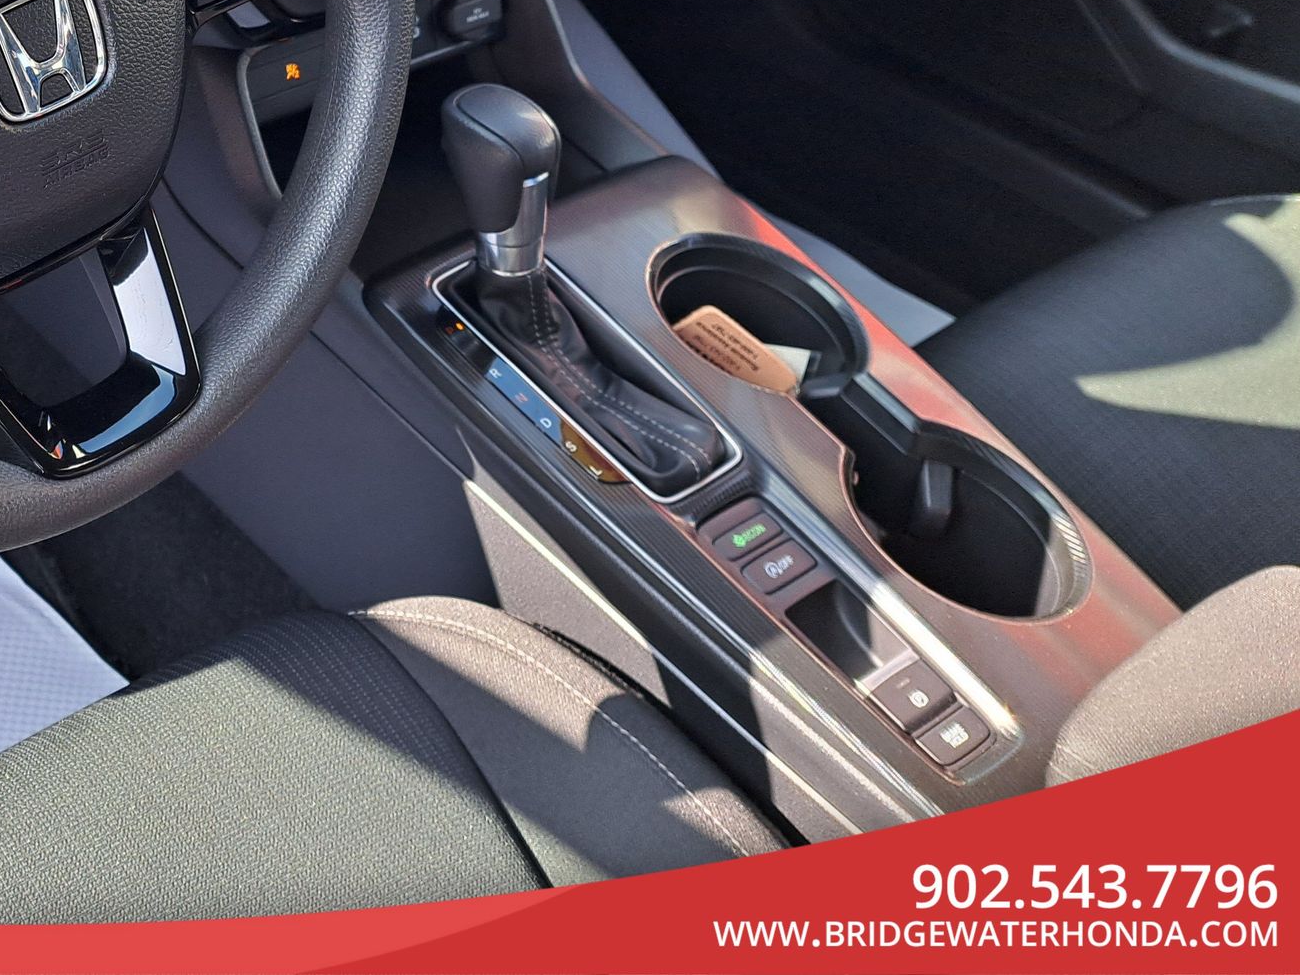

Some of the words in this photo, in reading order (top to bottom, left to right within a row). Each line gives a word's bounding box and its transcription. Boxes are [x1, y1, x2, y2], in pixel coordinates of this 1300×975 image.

[488, 368, 502, 379] R
[539, 417, 552, 429] D
[565, 440, 578, 453] S
[589, 465, 603, 476] L
